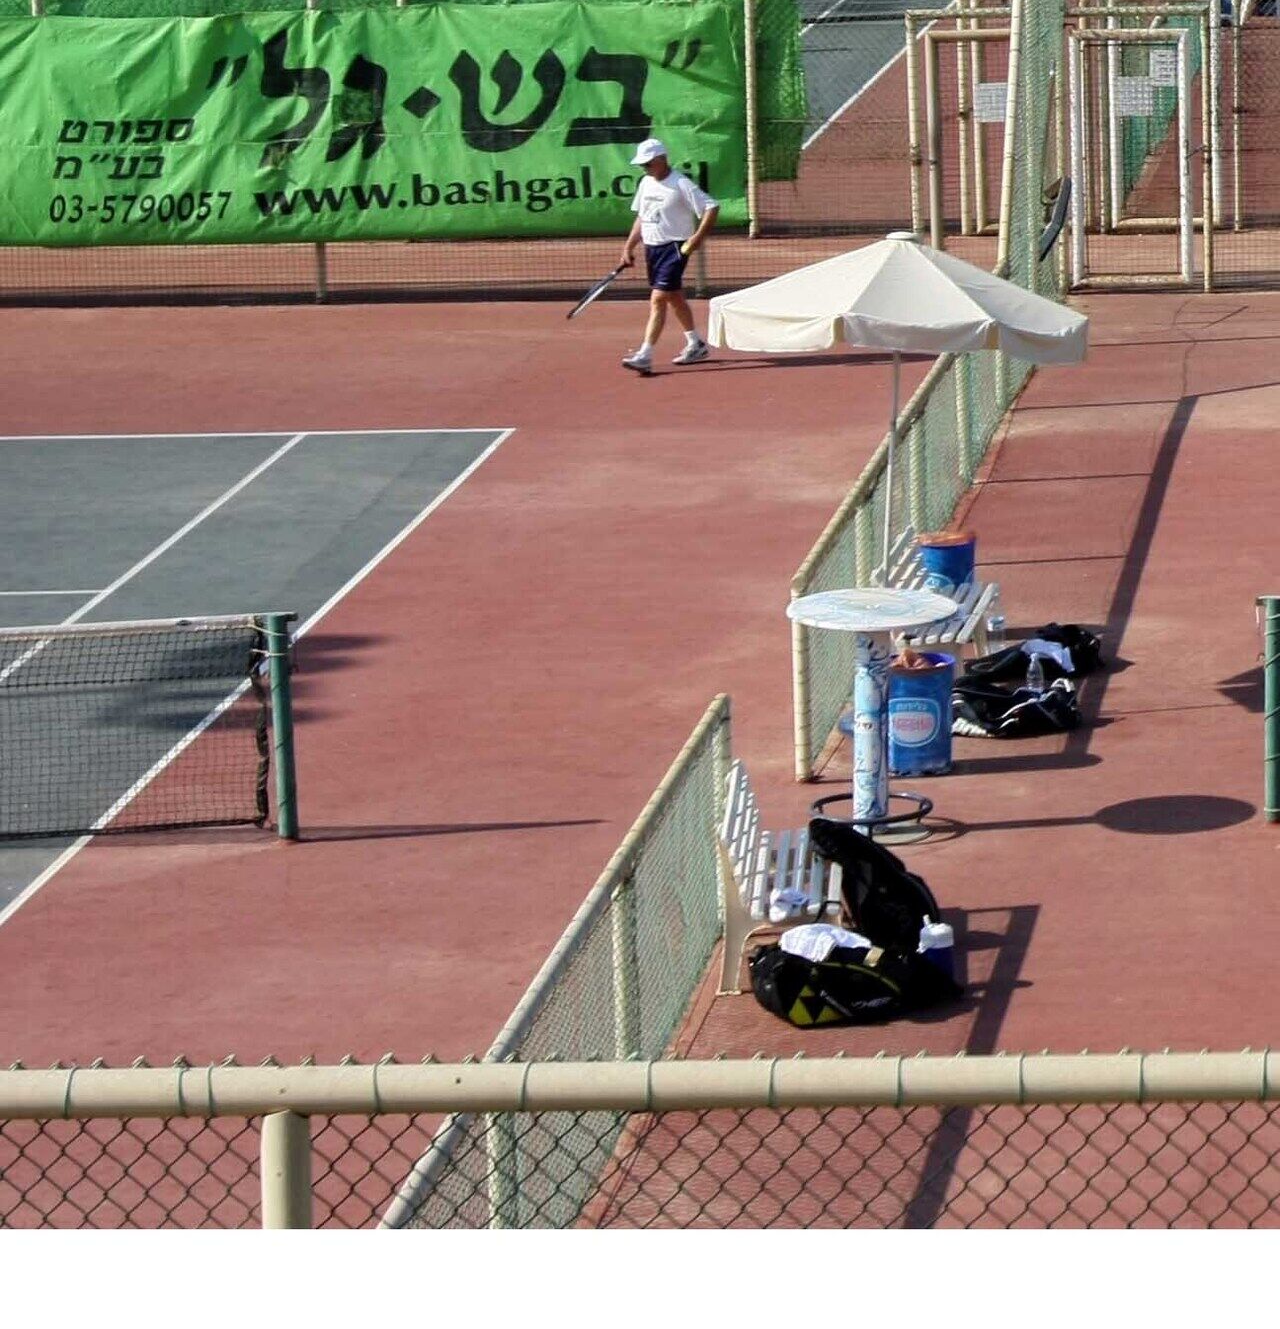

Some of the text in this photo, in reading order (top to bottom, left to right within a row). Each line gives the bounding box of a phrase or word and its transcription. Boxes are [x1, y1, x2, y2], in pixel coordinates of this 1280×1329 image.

[58, 118, 194, 145] ספורט
[54, 152, 164, 180] בע"מ
[49, 190, 232, 224] 03-5790057
